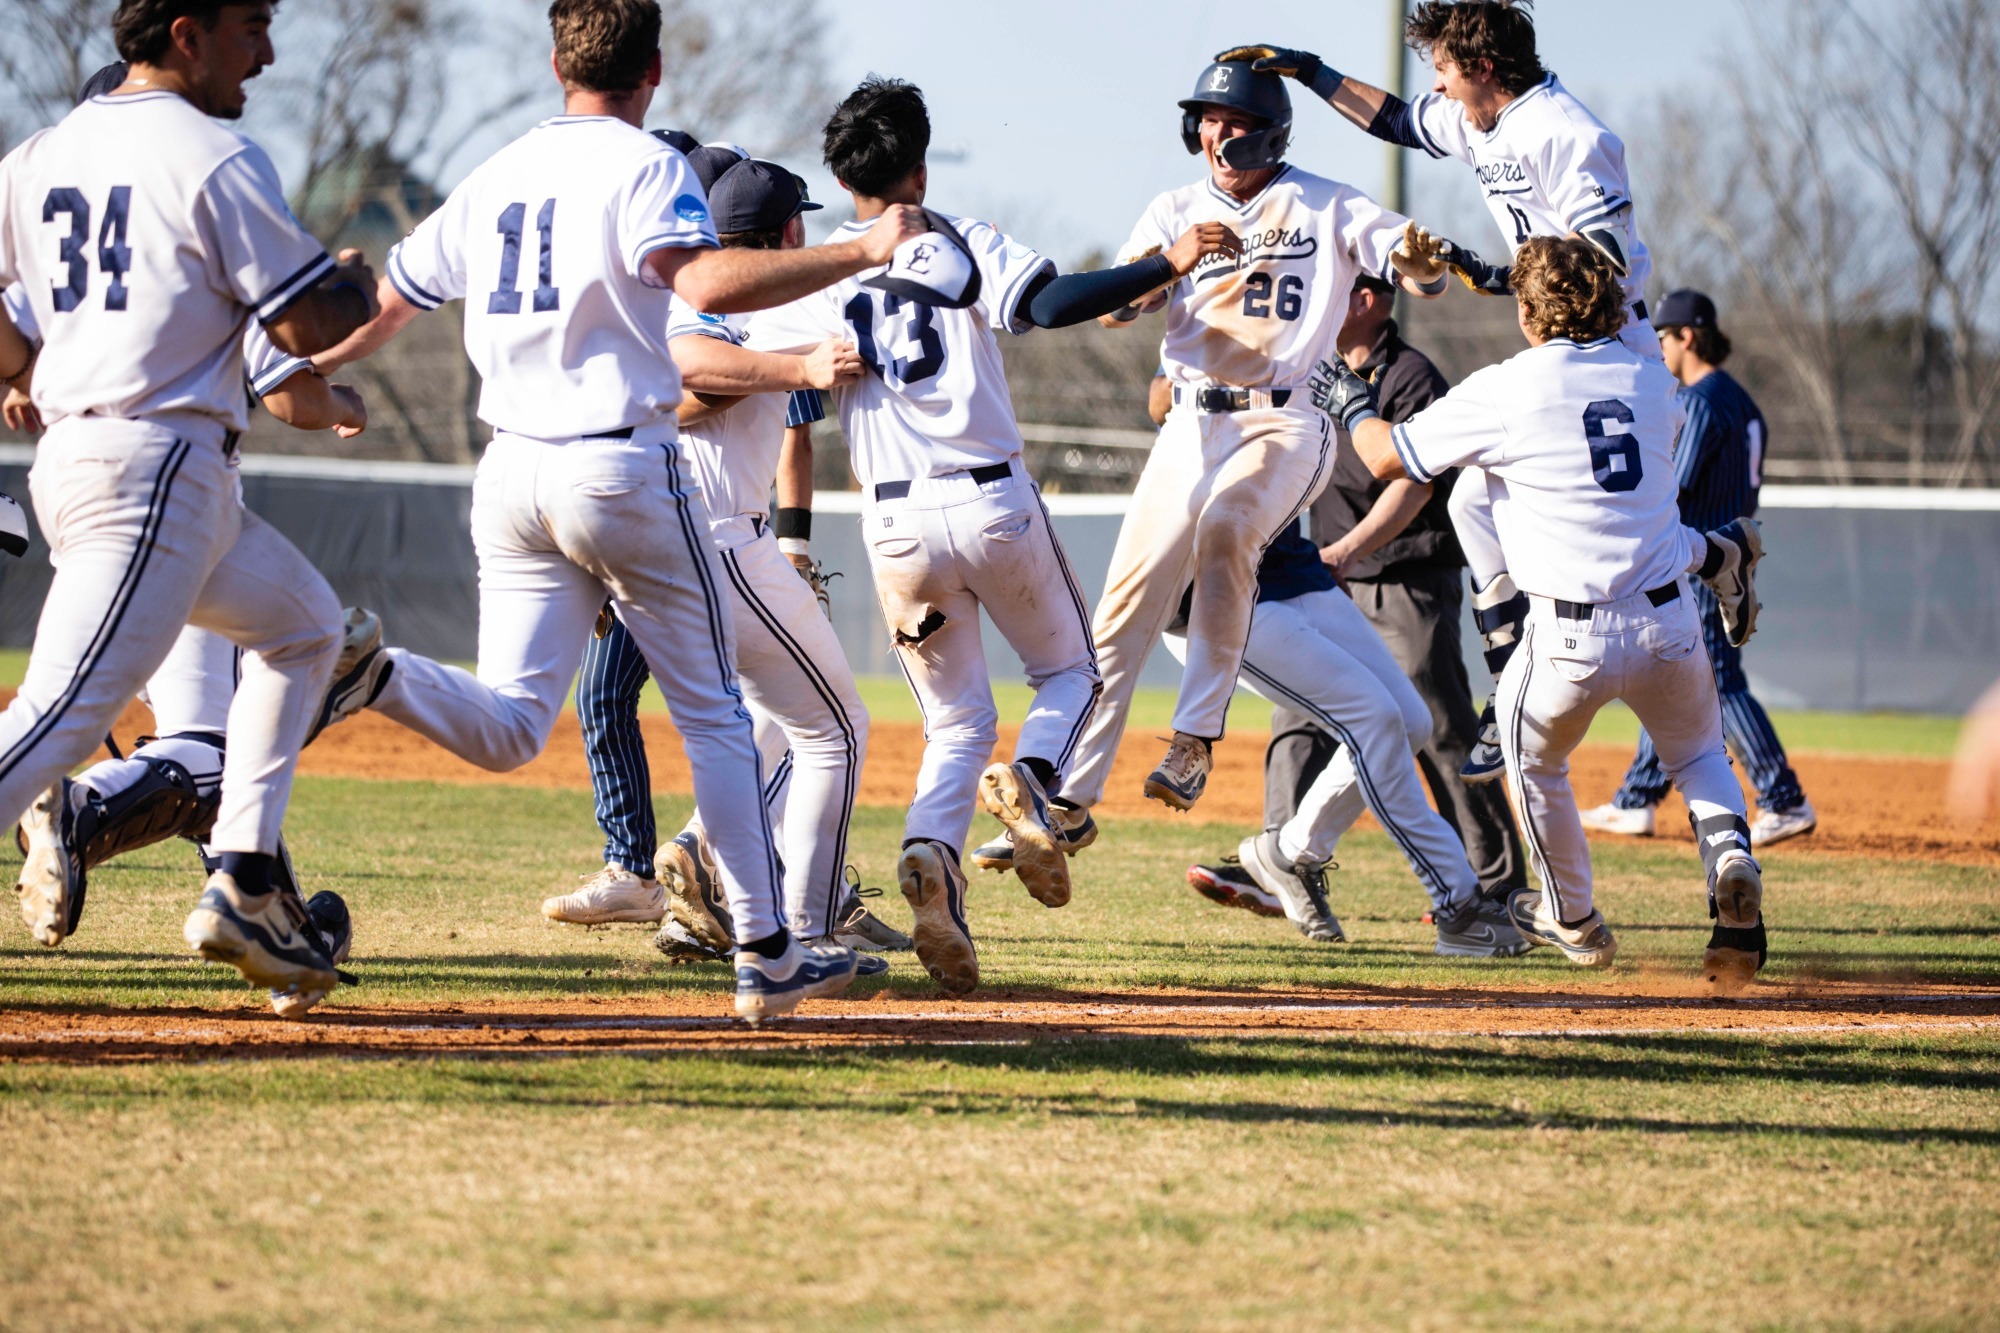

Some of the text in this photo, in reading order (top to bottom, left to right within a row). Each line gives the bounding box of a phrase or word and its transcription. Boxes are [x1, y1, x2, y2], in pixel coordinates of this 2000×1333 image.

[42, 186, 133, 312] 34
[487, 198, 560, 314] 11
[1243, 272, 1304, 321] 26
[845, 291, 945, 385] 13
[1582, 398, 1644, 493] 6
